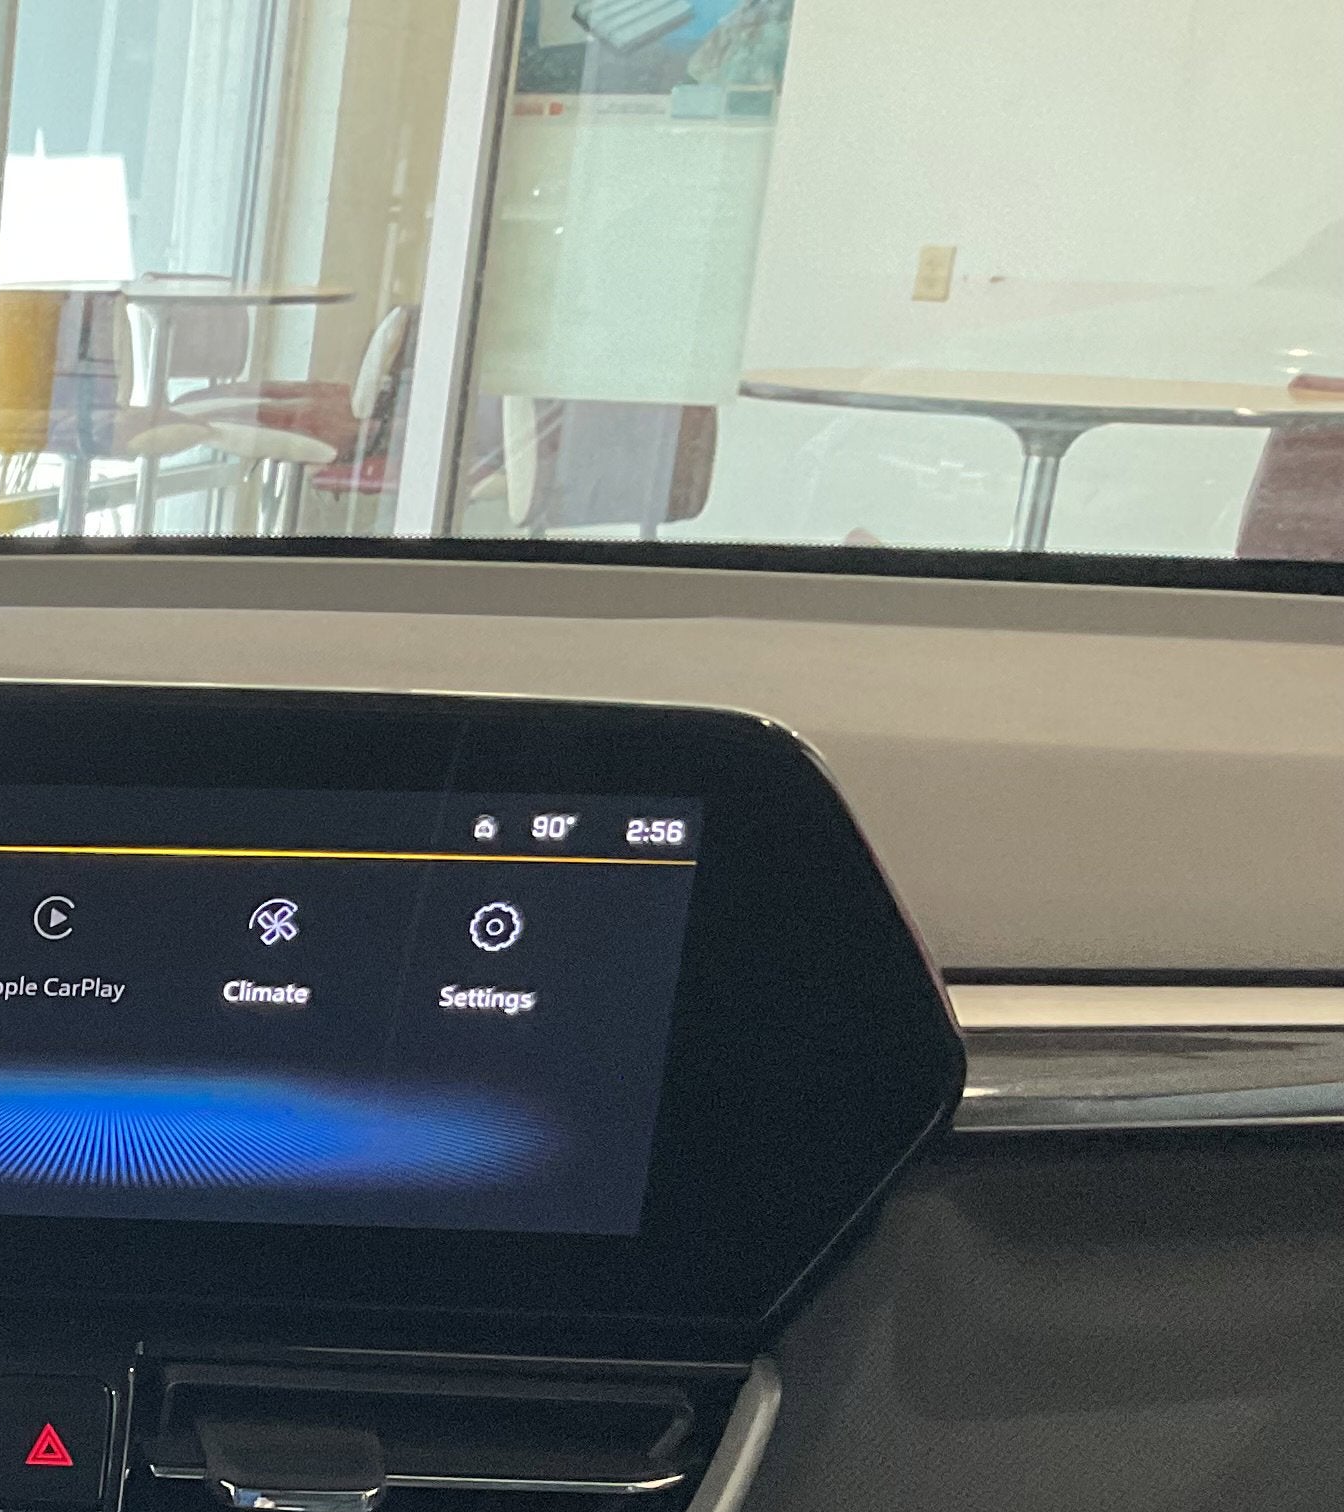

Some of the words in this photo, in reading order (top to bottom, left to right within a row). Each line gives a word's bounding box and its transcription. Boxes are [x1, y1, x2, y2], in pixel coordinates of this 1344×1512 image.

[625, 819, 684, 844] 2:56
[43, 977, 126, 1003] CarPlay
[222, 980, 310, 1005] Climate
[438, 985, 537, 1016] Settings
